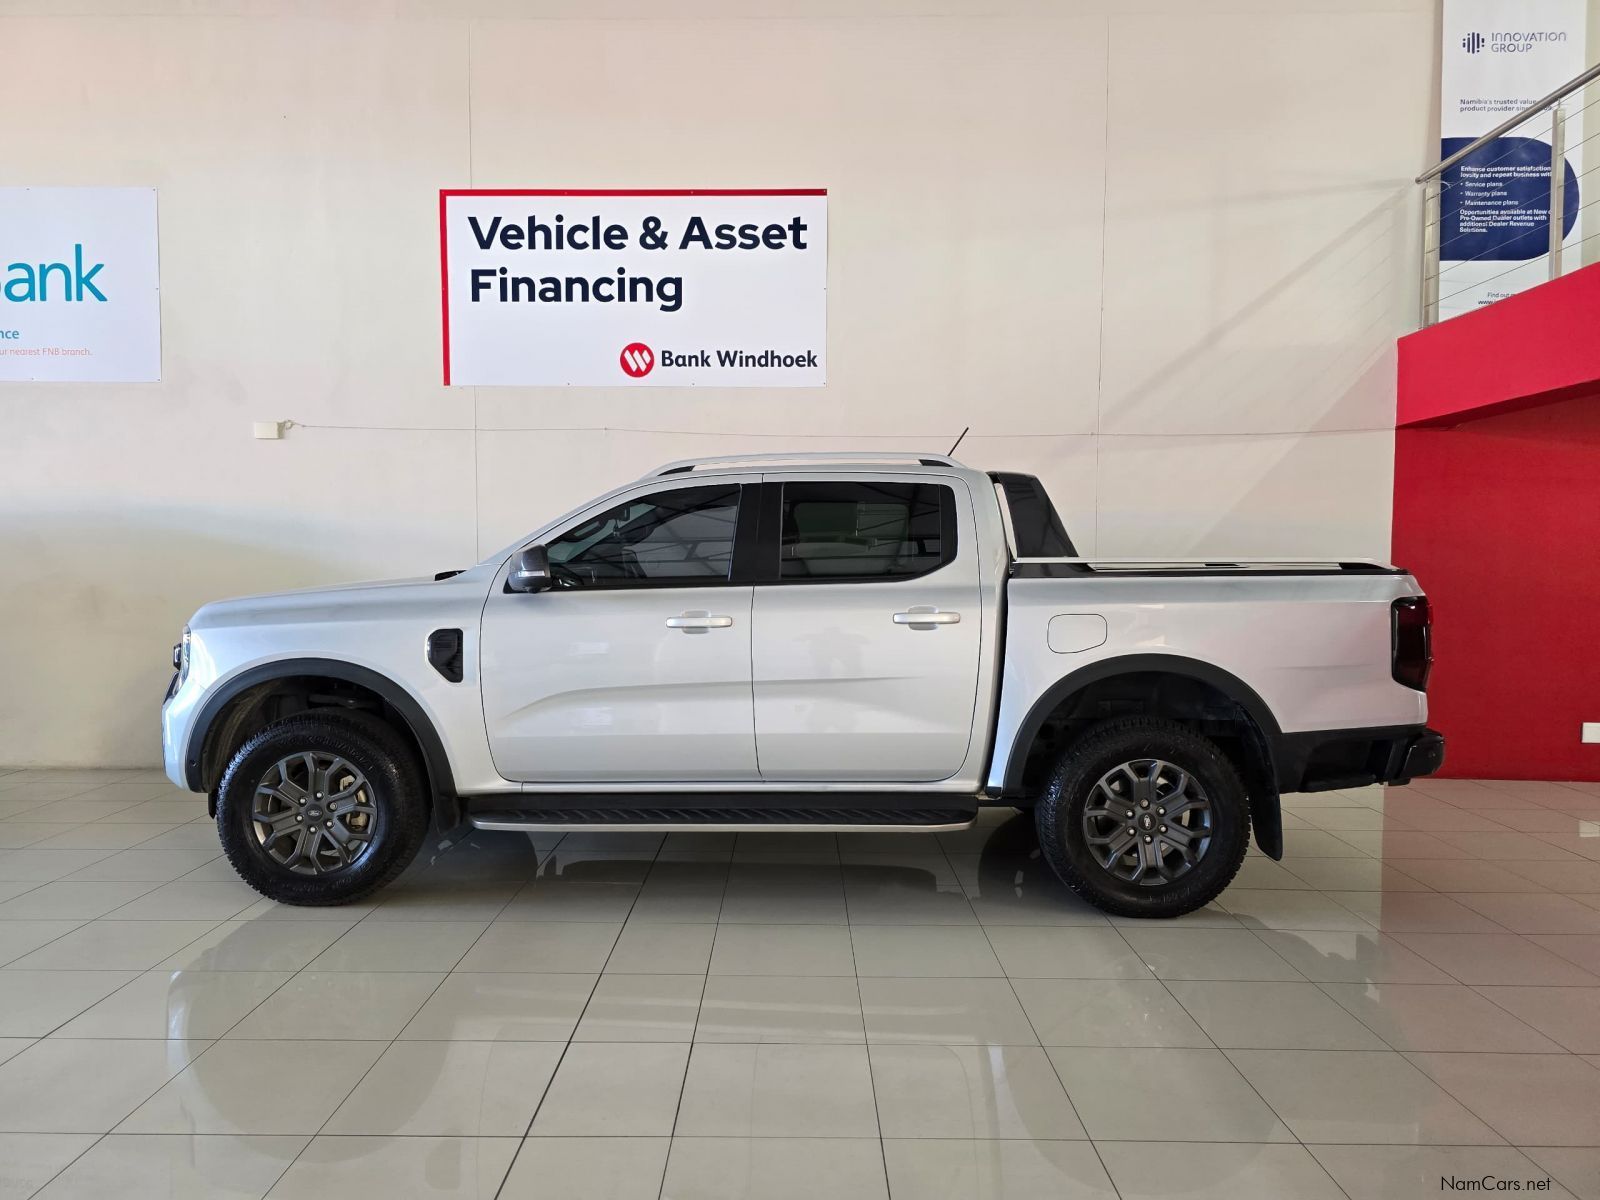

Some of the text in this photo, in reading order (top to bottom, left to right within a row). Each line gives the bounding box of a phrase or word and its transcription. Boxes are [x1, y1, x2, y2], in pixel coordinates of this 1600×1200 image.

[1491, 32, 1567, 42] INNOVATION
[1491, 43, 1533, 53] GROUP
[467, 214, 808, 251] Vehicle & Asset
[0, 244, 108, 303] ank
[470, 266, 683, 312] Financing
[10, 348, 41, 356] nearest
[42, 348, 60, 356] FNB
[62, 348, 94, 356] branch.
[661, 349, 818, 368] Bank Windhoek
